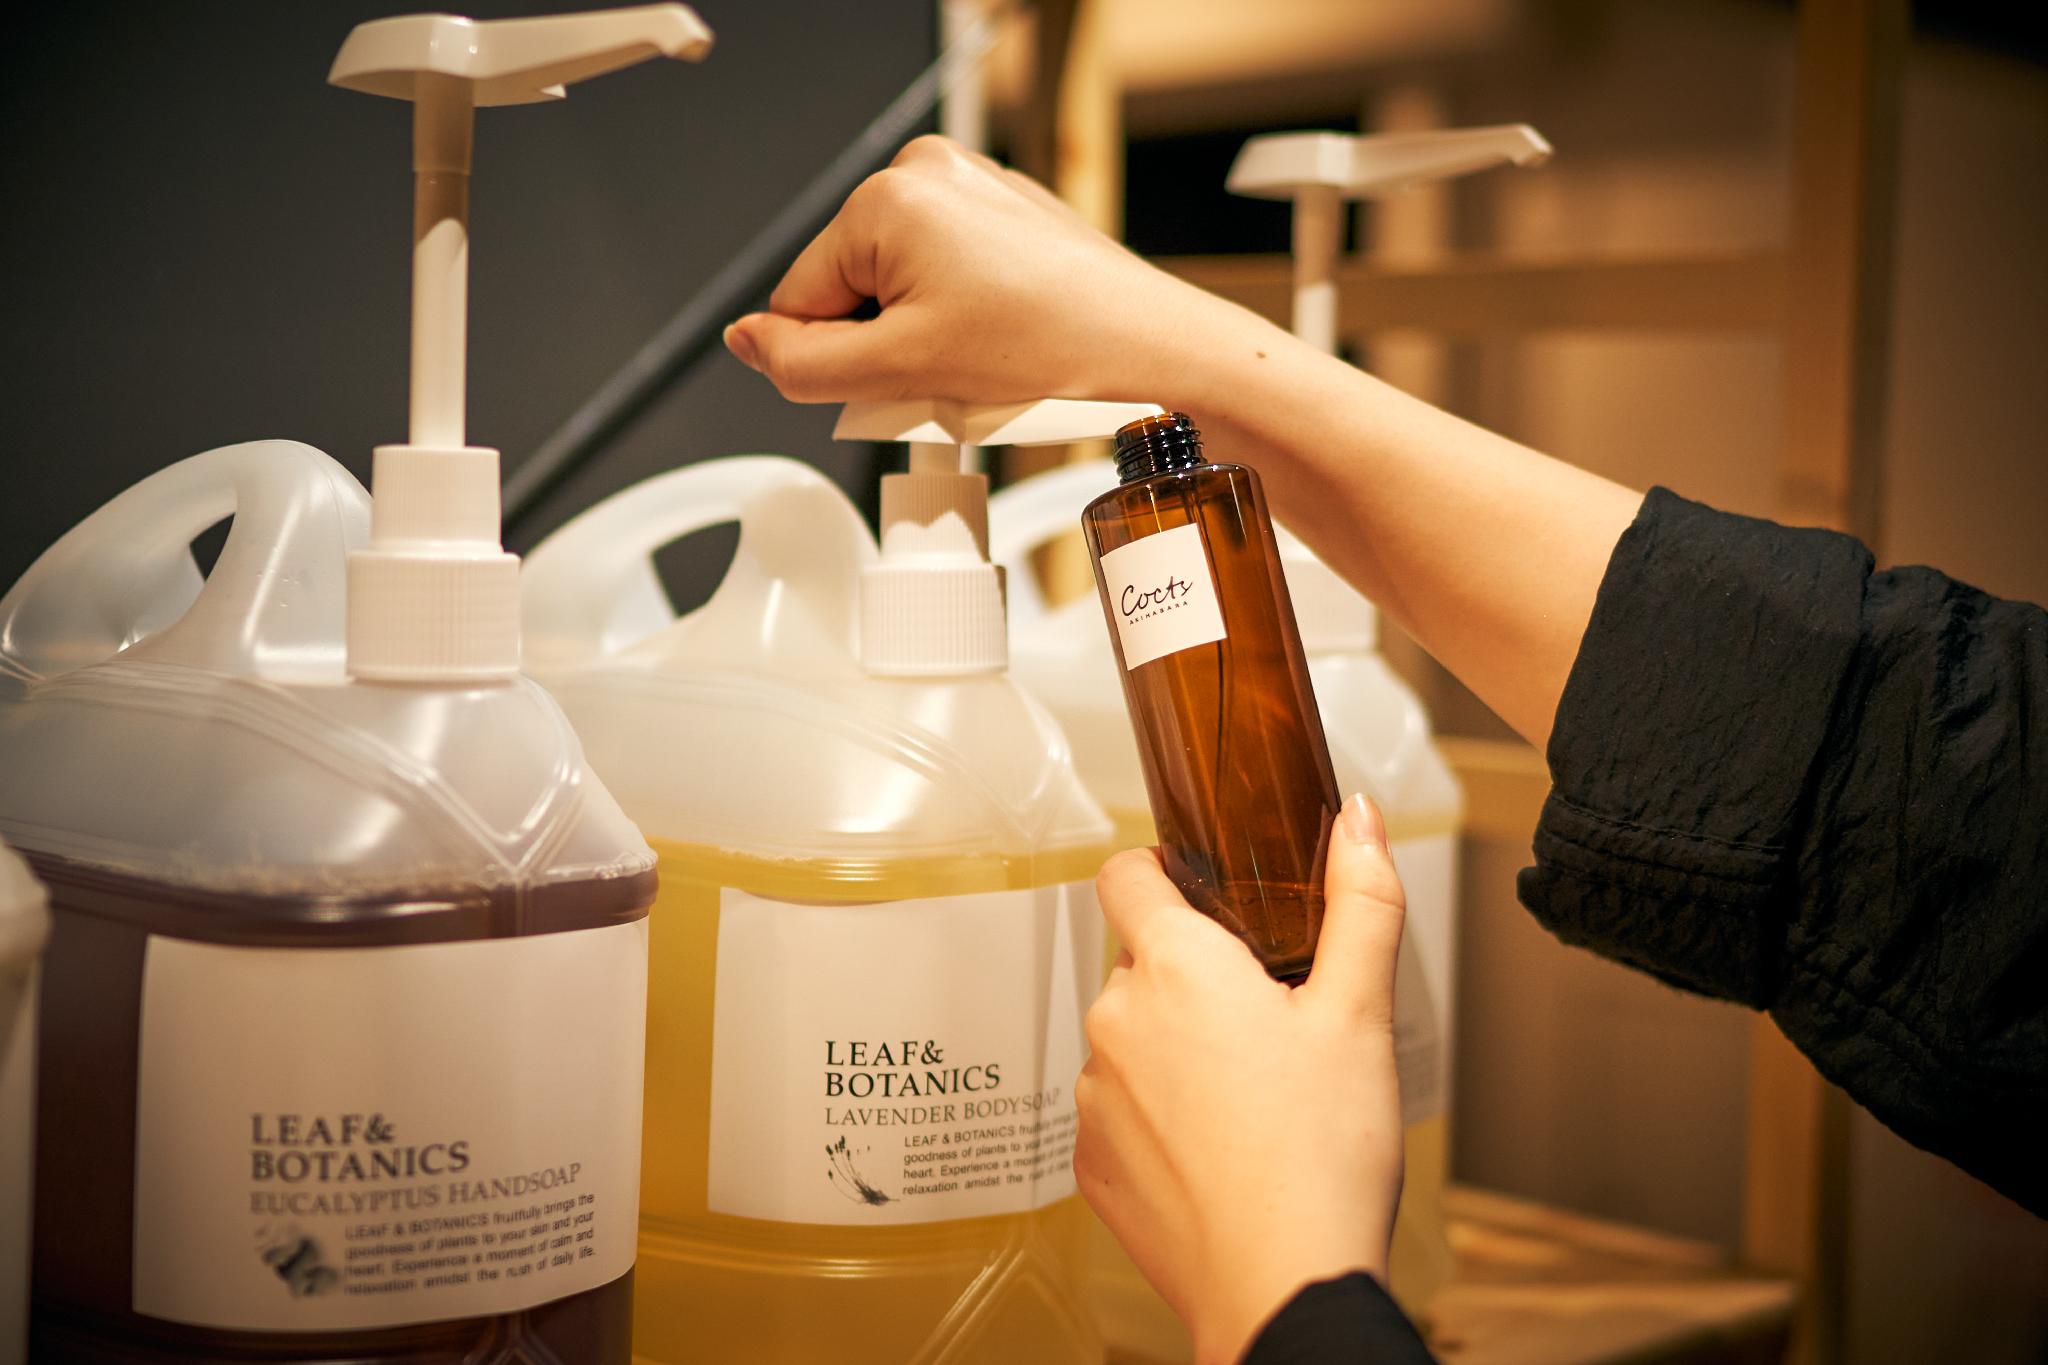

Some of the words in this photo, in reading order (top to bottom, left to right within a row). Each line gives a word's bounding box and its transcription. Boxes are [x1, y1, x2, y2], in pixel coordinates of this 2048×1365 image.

[1129, 601, 1188, 625] AKIHABARA
[825, 1040, 944, 1066] LEAF&
[825, 1064, 1000, 1097] BOTANICS
[825, 1105, 956, 1126] LAVENDER
[963, 1087, 1062, 1120] BODYSOAP
[250, 1113, 395, 1146] LEAF&
[905, 1134, 937, 1148] LEAF
[943, 1133, 950, 1145] &
[954, 1125, 1015, 1143] BOTANICS
[251, 1141, 470, 1183] BOTANICS
[904, 1150, 957, 1166] goodness
[962, 1147, 972, 1158] of
[976, 1144, 1007, 1158] plants
[1010, 1143, 1020, 1152] to
[940, 1160, 999, 1177] Experience
[1003, 1161, 1010, 1169] a
[250, 1184, 440, 1215] EUCALYPTUS
[449, 1162, 581, 1204] HANDSOAP
[902, 1181, 958, 1196] relaxation
[965, 1176, 1000, 1190] amidst
[1006, 1173, 1023, 1184] the
[578, 1194, 594, 1206] the
[552, 1217, 571, 1231] and
[573, 1211, 594, 1227] your
[550, 1234, 573, 1249] calm
[576, 1228, 594, 1243] and
[552, 1251, 574, 1267] daily
